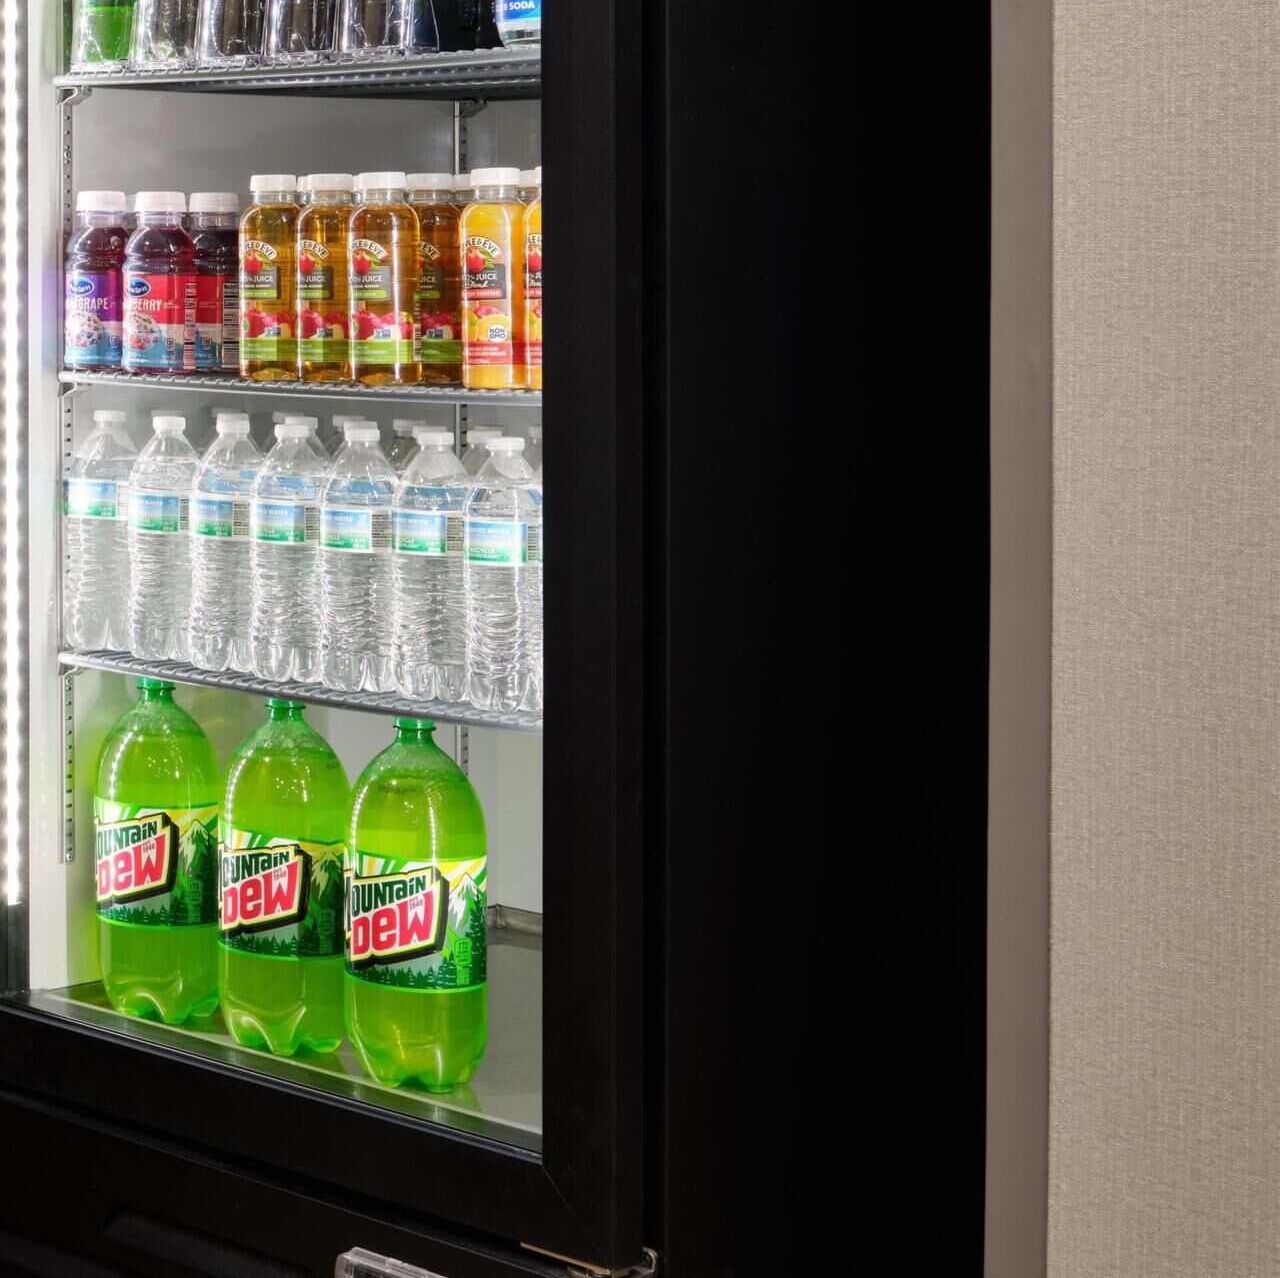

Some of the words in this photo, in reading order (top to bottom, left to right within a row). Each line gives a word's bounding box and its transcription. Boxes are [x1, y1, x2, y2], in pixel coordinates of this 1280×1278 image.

[509, 1, 536, 11] SODA
[253, 275, 275, 283] JUICE
[361, 275, 383, 283] JUICE
[475, 273, 498, 281] JUICE
